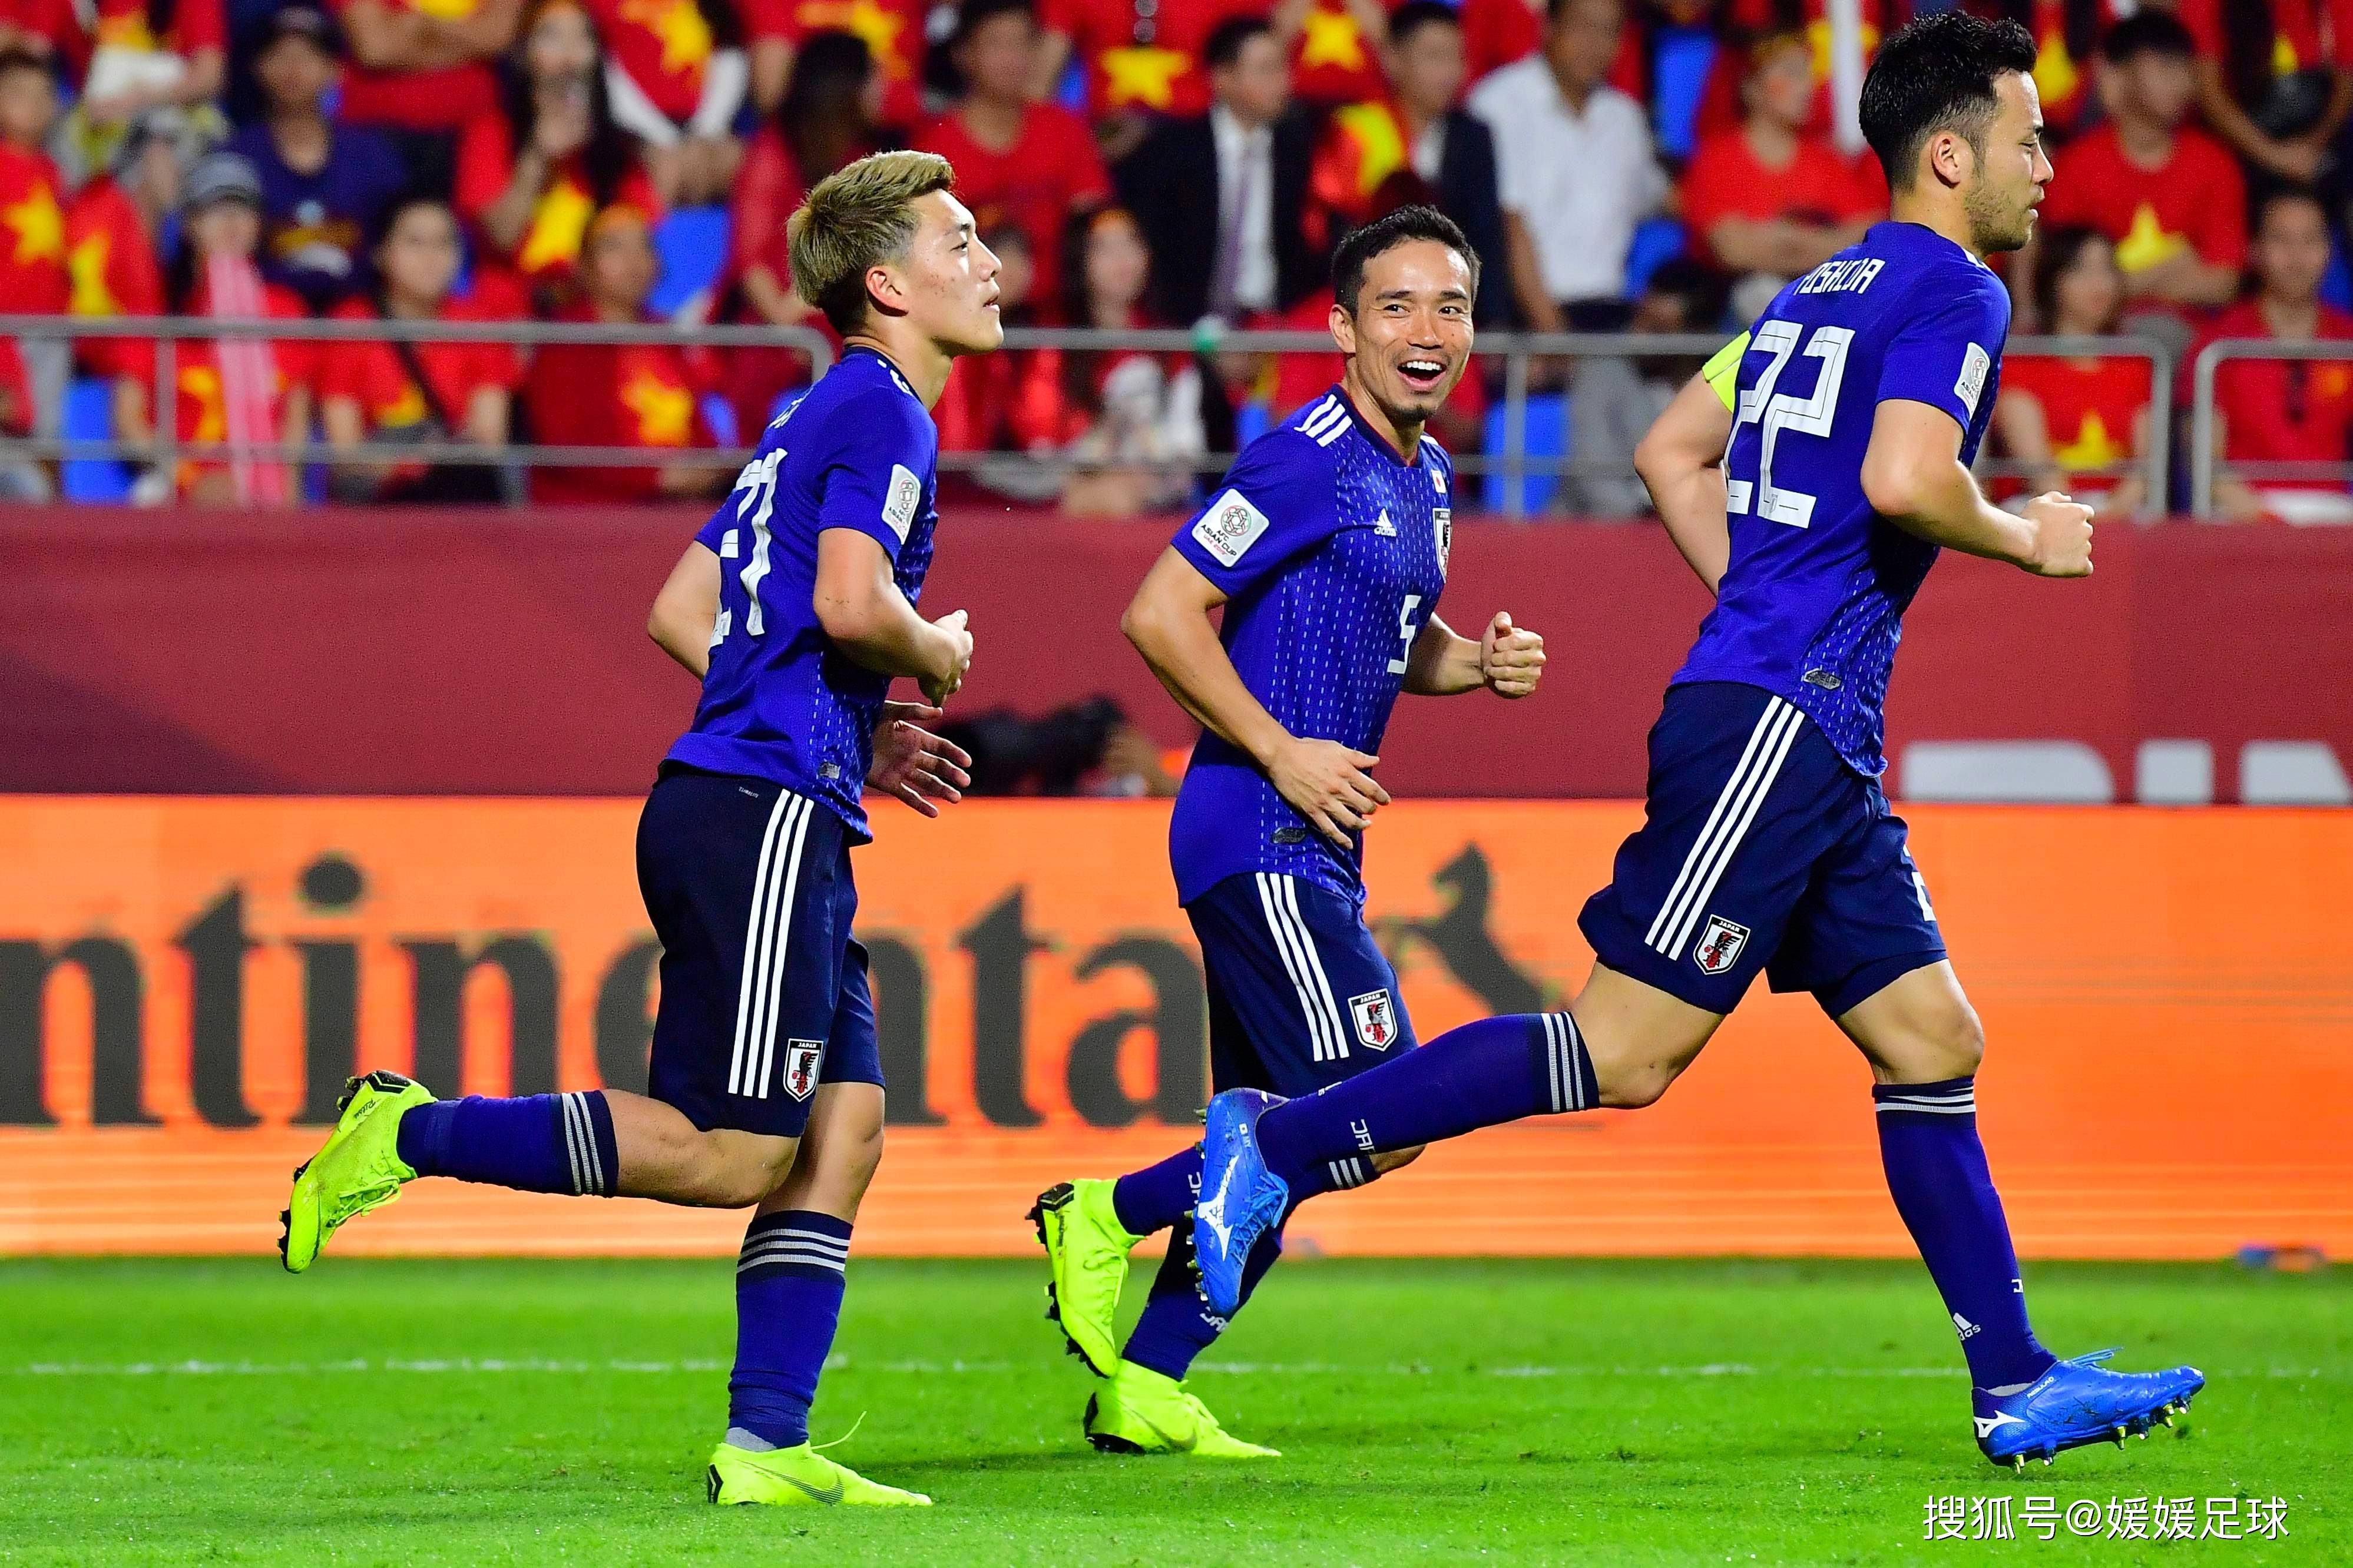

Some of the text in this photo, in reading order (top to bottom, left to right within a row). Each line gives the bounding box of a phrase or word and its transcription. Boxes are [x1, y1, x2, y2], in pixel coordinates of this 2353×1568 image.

[1719, 320, 1855, 528] 22
[707, 447, 788, 648] 21
[1200, 524, 1237, 556] ASIAN CUP
[1217, 530, 1229, 542] AFC
[1386, 594, 1422, 675] 5
[1719, 921, 1740, 932] JAPAN
[1360, 993, 1381, 1003] JAPAN
[353, 1098, 376, 1119] Ritsu
